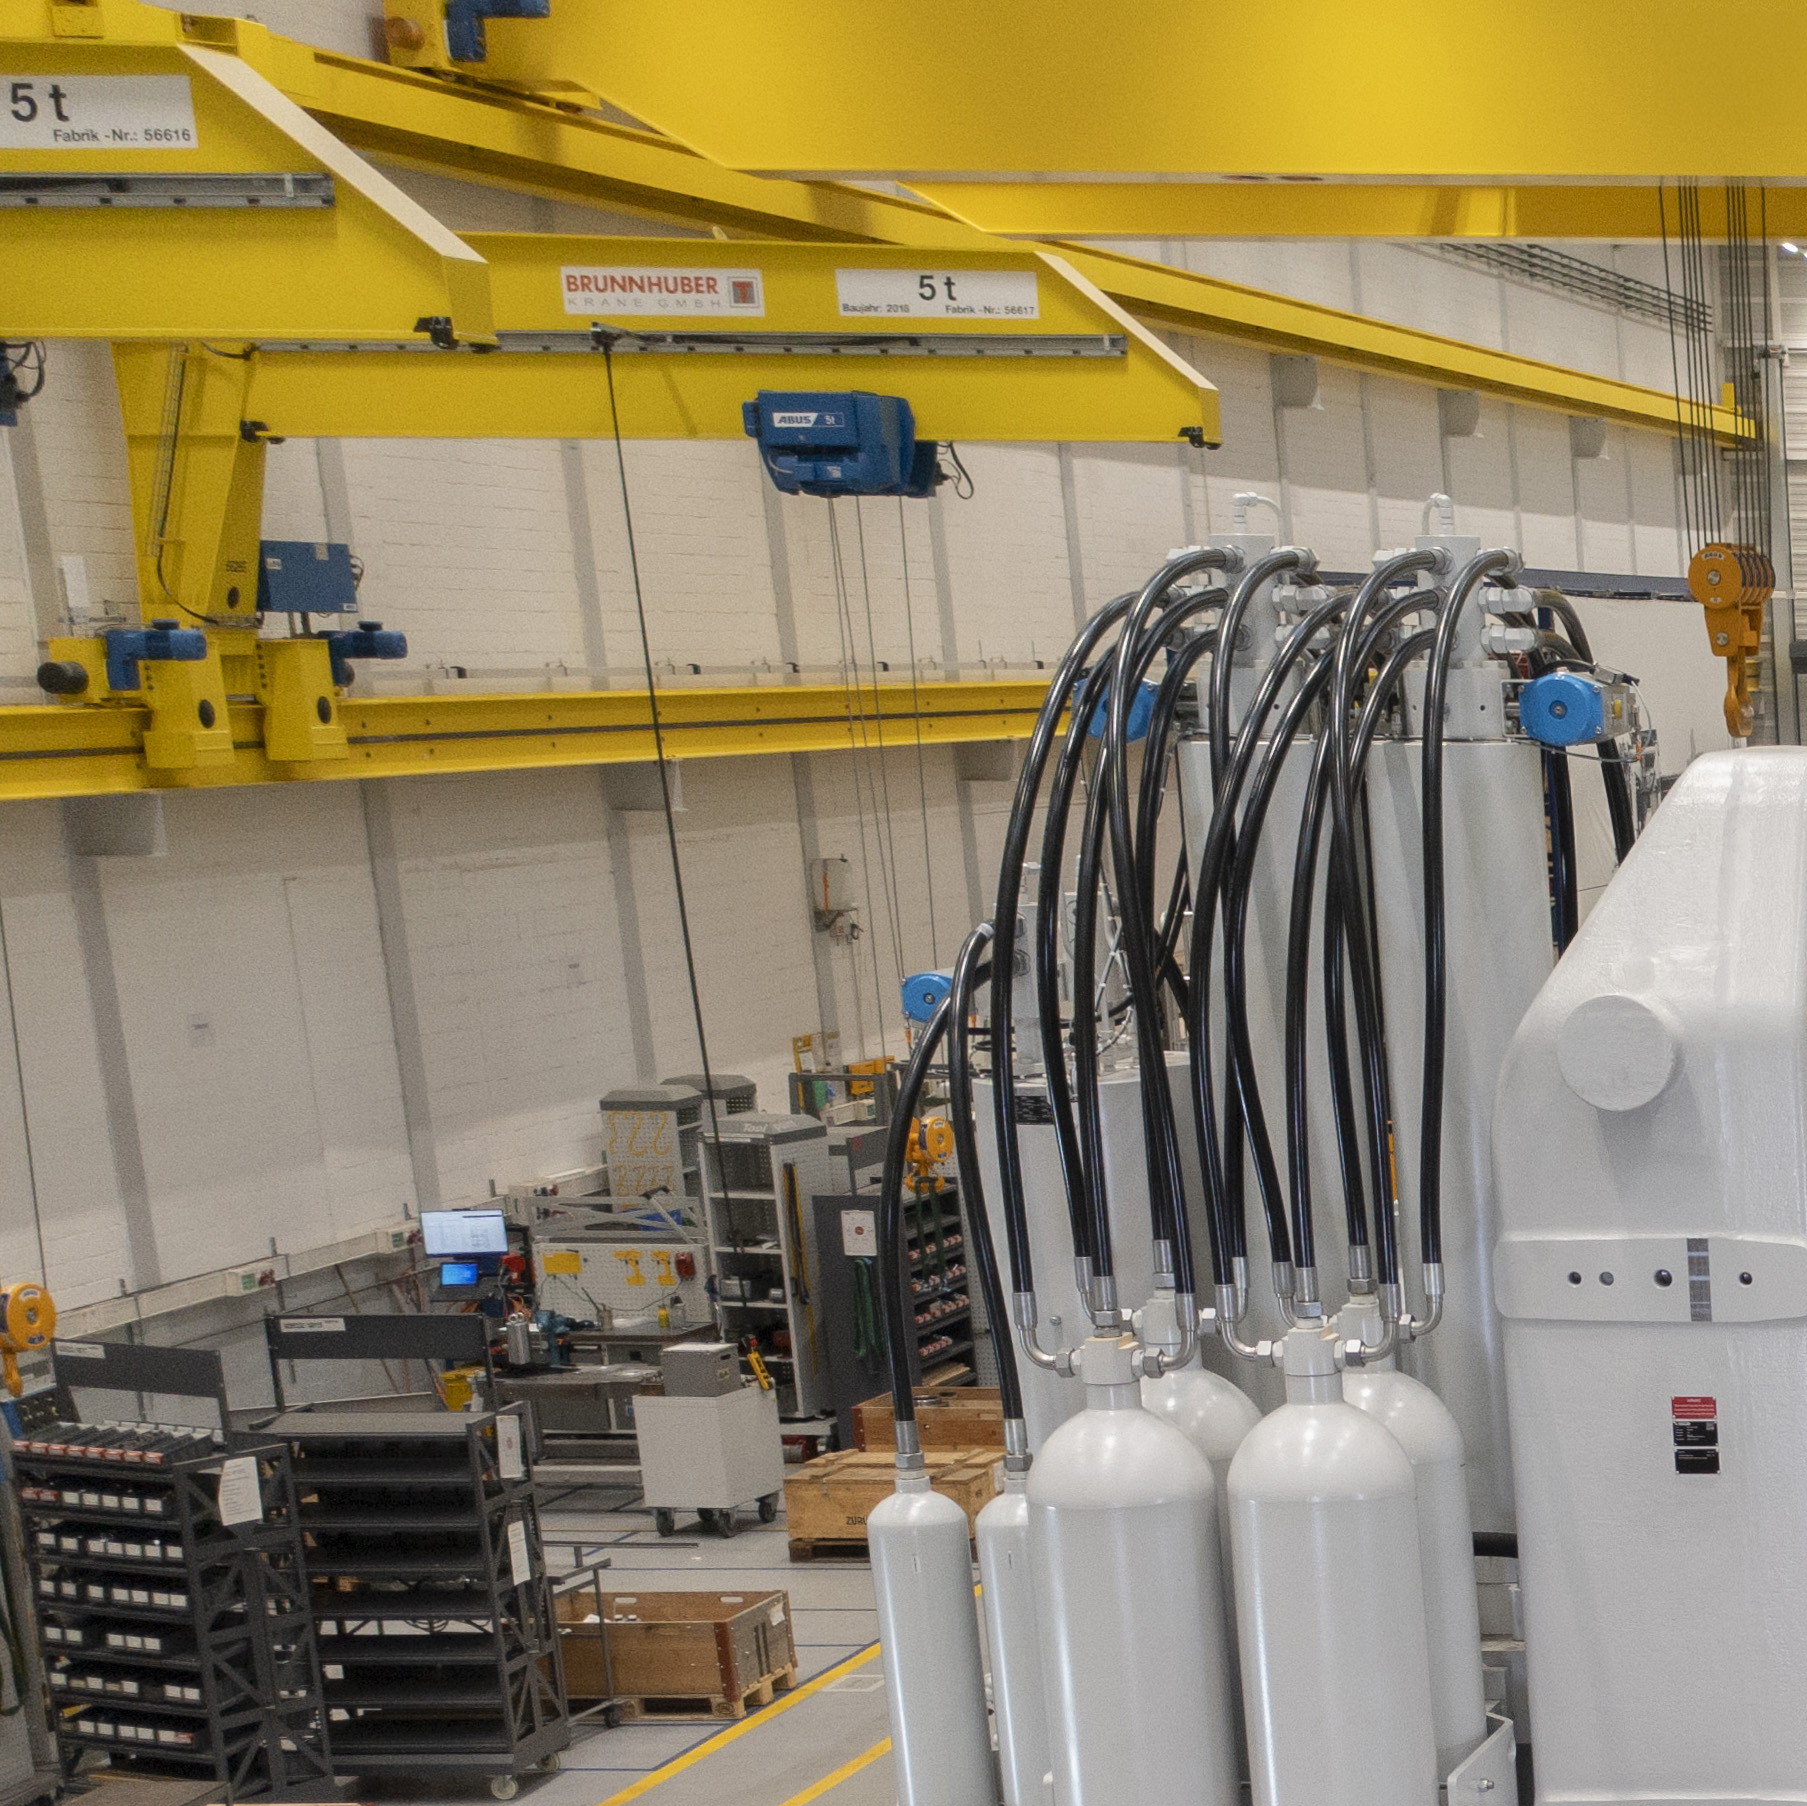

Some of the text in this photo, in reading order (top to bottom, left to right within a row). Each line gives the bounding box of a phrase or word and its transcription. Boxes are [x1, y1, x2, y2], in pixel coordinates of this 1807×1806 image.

[11, 82, 71, 123] 5 t
[53, 128, 100, 143] Fabrik
[144, 128, 191, 142] 56616
[565, 274, 719, 295] BRUNNHUBER
[918, 274, 958, 301] 5 t
[568, 297, 721, 309] KRANE GMBH
[777, 415, 812, 425] ABUS
